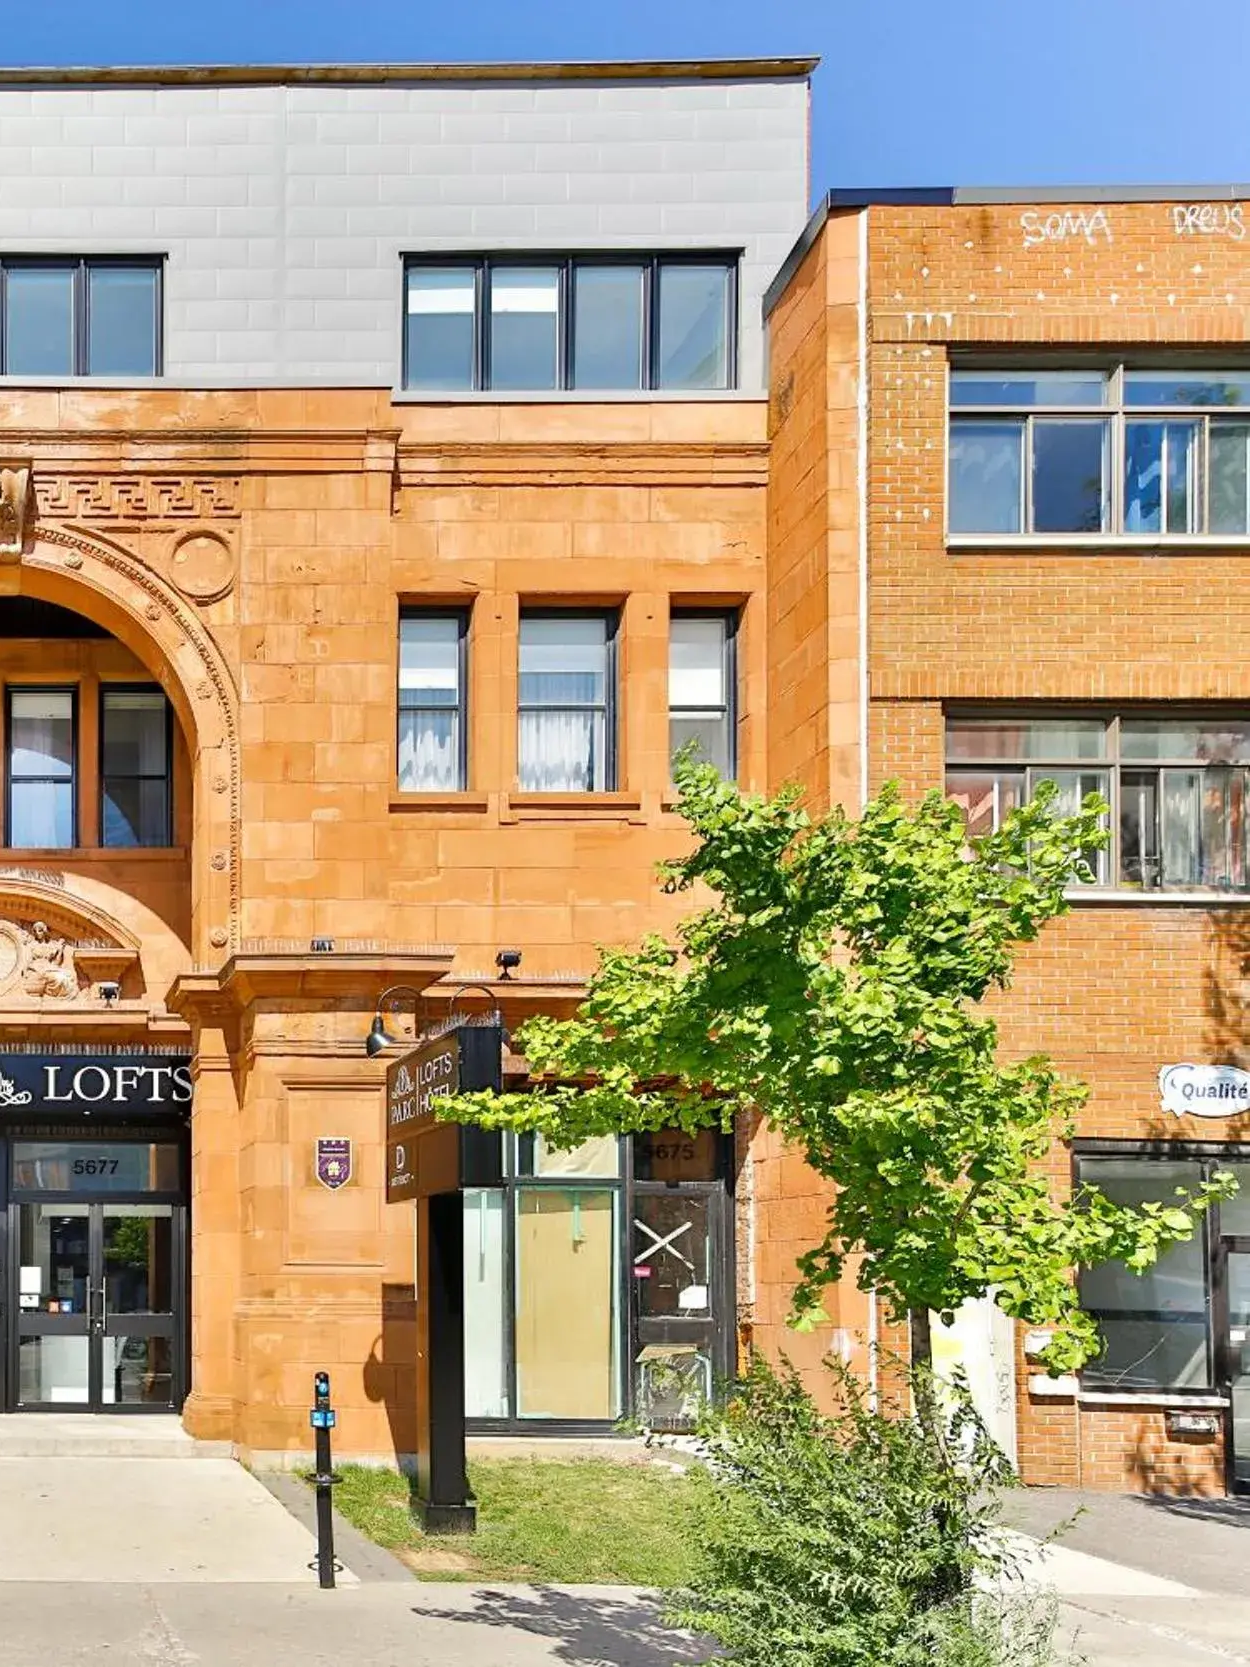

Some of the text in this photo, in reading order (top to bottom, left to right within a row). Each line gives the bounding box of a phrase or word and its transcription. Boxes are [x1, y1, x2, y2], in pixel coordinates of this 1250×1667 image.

[419, 1052, 453, 1085] LOFTS
[43, 1064, 193, 1101] LOFTS
[1182, 1081, 1248, 1101] Qualité
[390, 1096, 416, 1125] PARC
[643, 1143, 694, 1160] 5675
[73, 1159, 119, 1175] 5677
